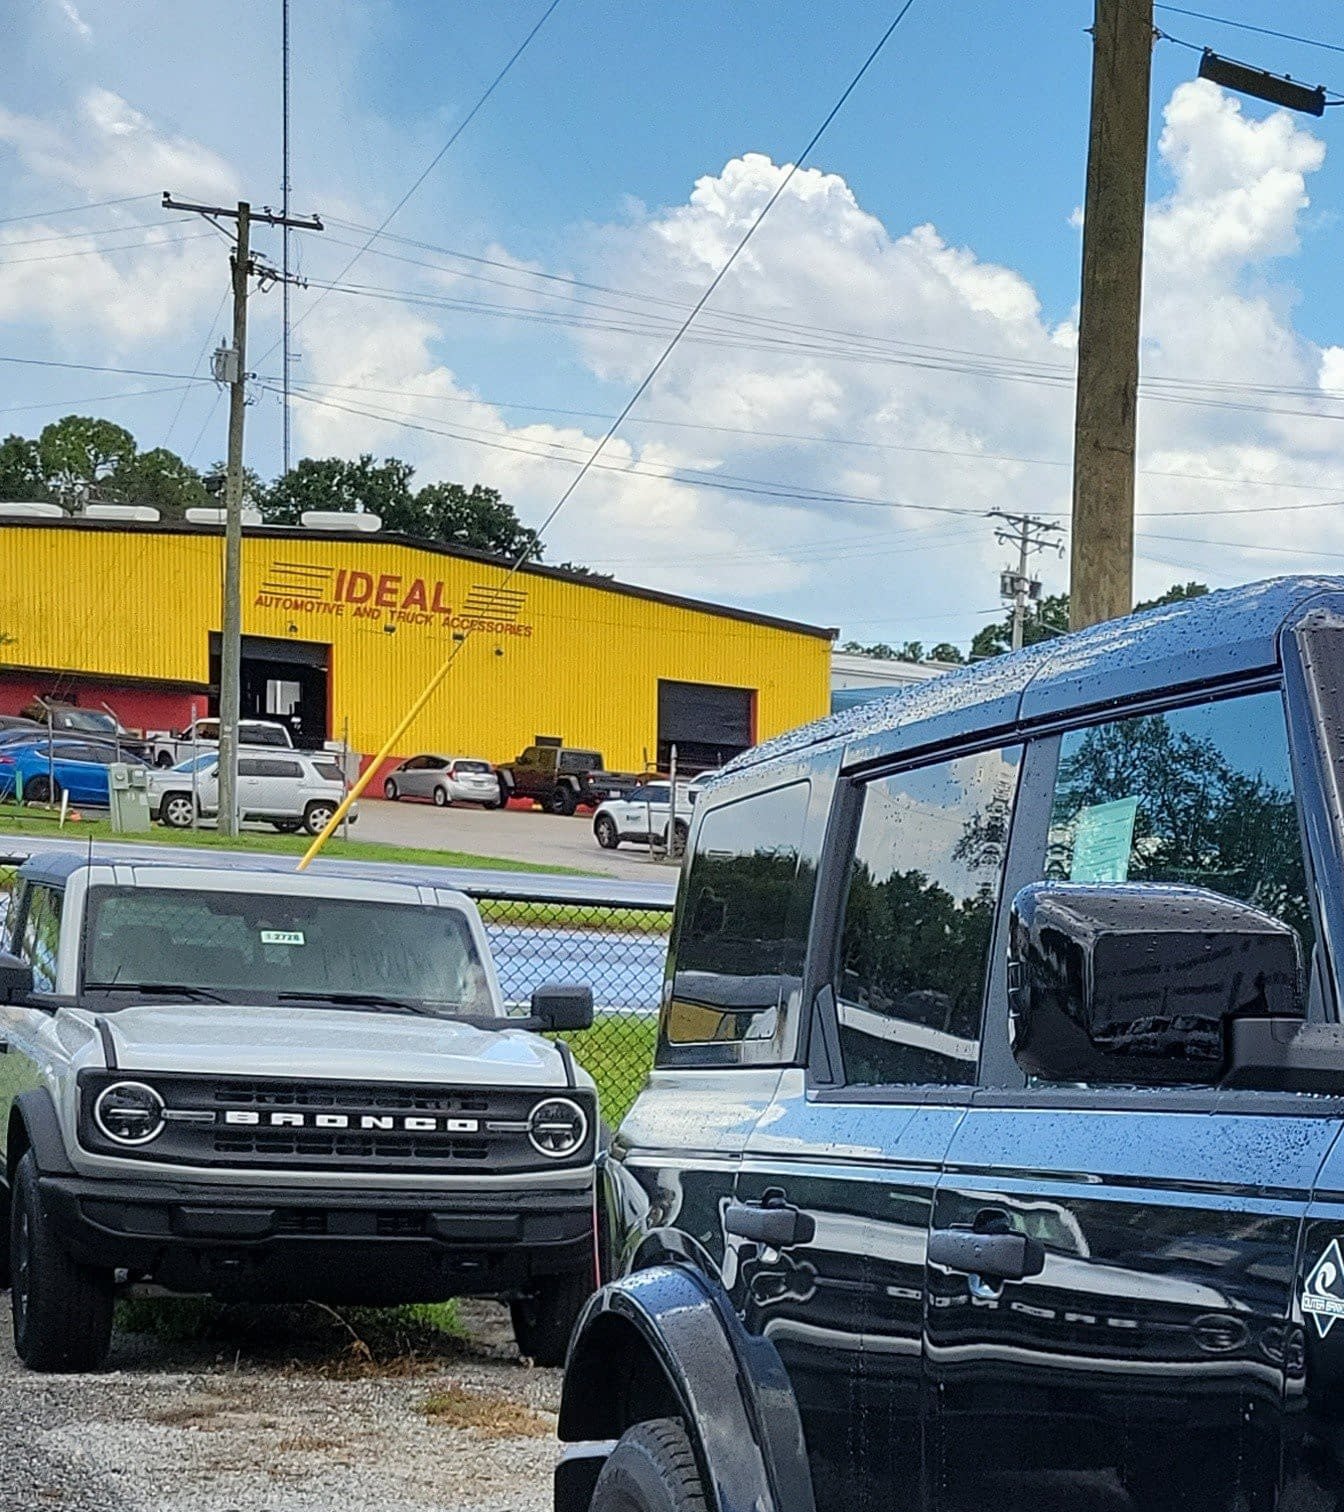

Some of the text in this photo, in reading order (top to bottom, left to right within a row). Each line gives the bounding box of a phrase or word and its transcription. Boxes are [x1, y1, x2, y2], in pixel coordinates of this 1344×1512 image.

[334, 569, 452, 613] IDEAL
[255, 595, 533, 638] AUTOMOTIVE AND TRUCK ACCESSORIES
[225, 1110, 479, 1132] BRONCO
